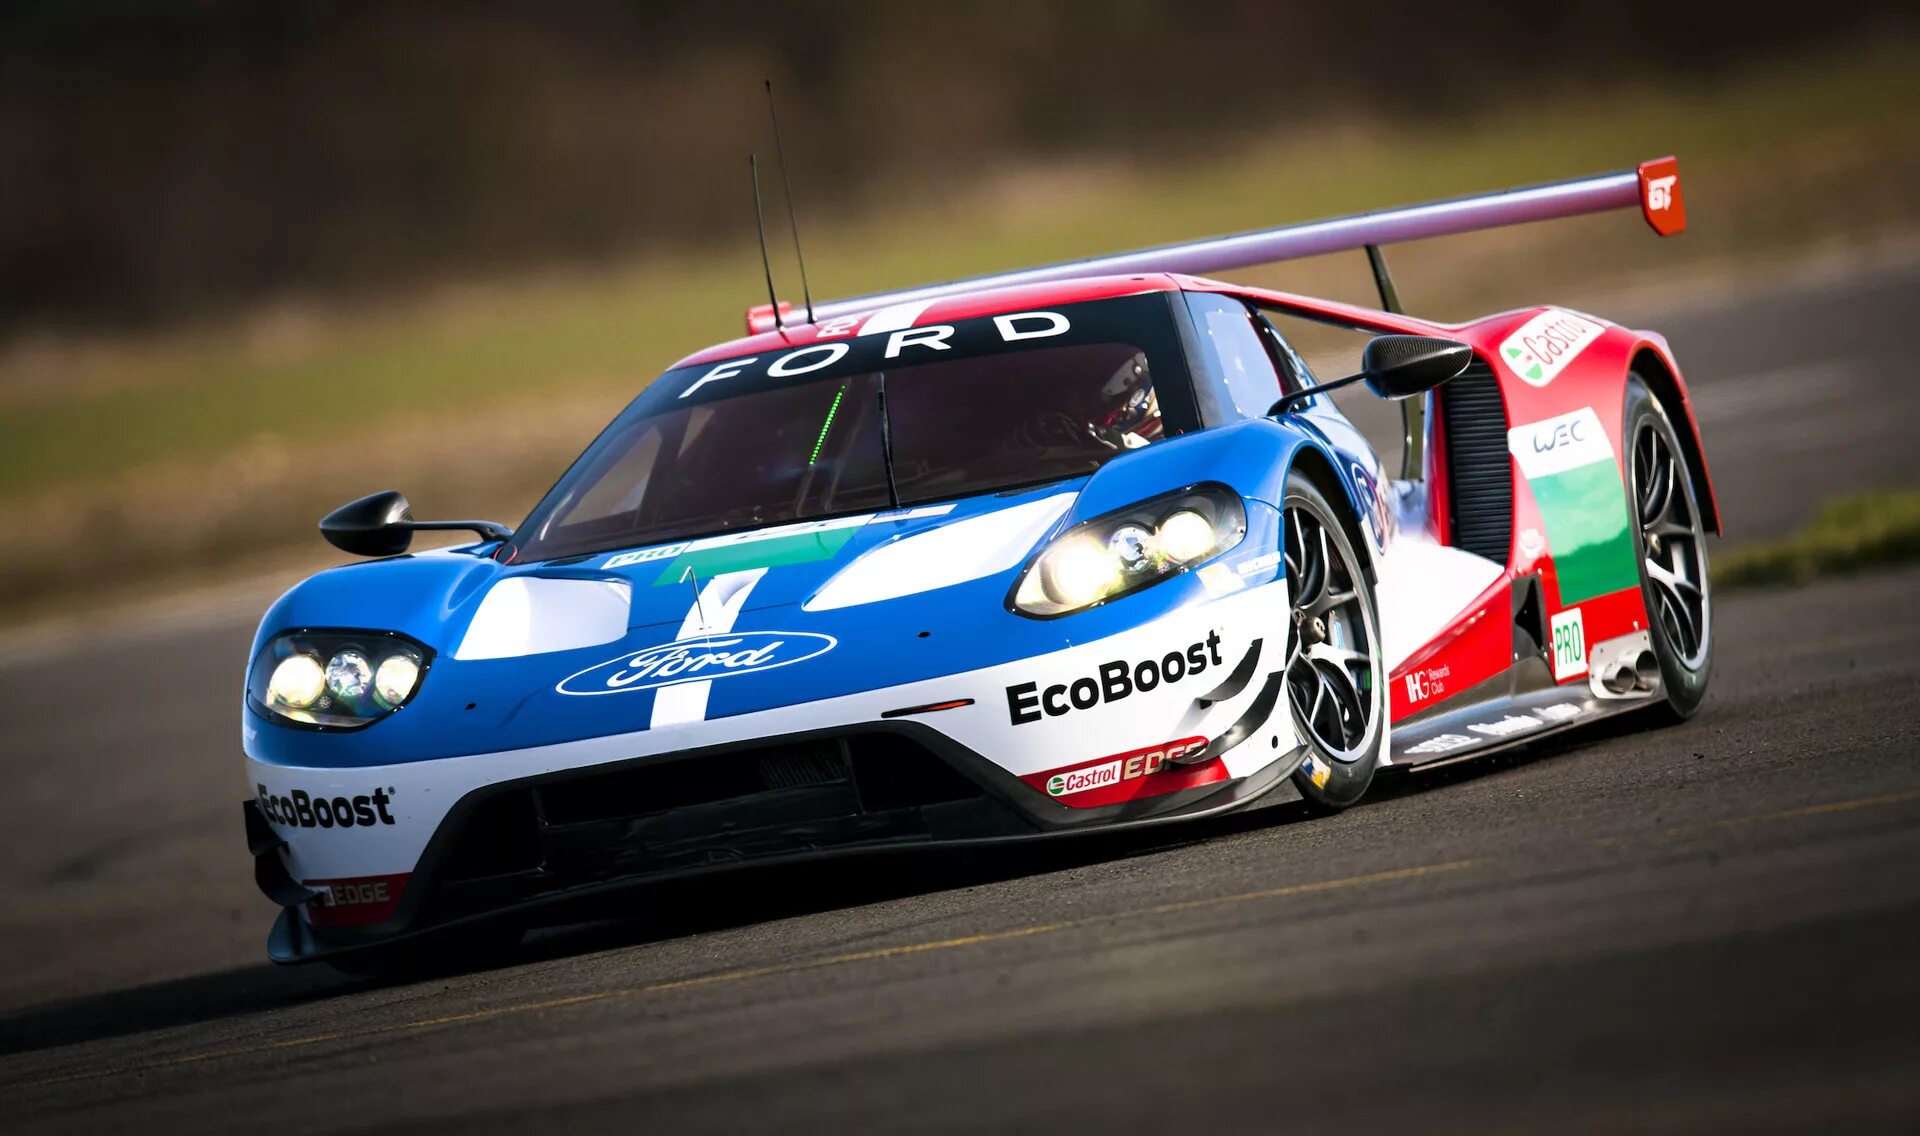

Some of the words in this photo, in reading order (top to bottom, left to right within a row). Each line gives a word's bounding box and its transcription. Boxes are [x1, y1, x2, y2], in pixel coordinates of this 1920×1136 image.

[1647, 175, 1677, 211] GT
[678, 311, 1071, 399] FORD
[1522, 317, 1591, 365] Castro
[1533, 420, 1585, 453] WEC
[609, 546, 682, 566] PRO
[606, 638, 785, 688] Ford
[1555, 621, 1581, 667] PRO
[1005, 629, 1223, 726] EcoBoost
[1405, 671, 1430, 704] IHG
[1428, 664, 1451, 681] Rewards
[1431, 680, 1445, 695] Club
[1065, 765, 1117, 792] Castrol
[336, 881, 391, 905] EDGE
